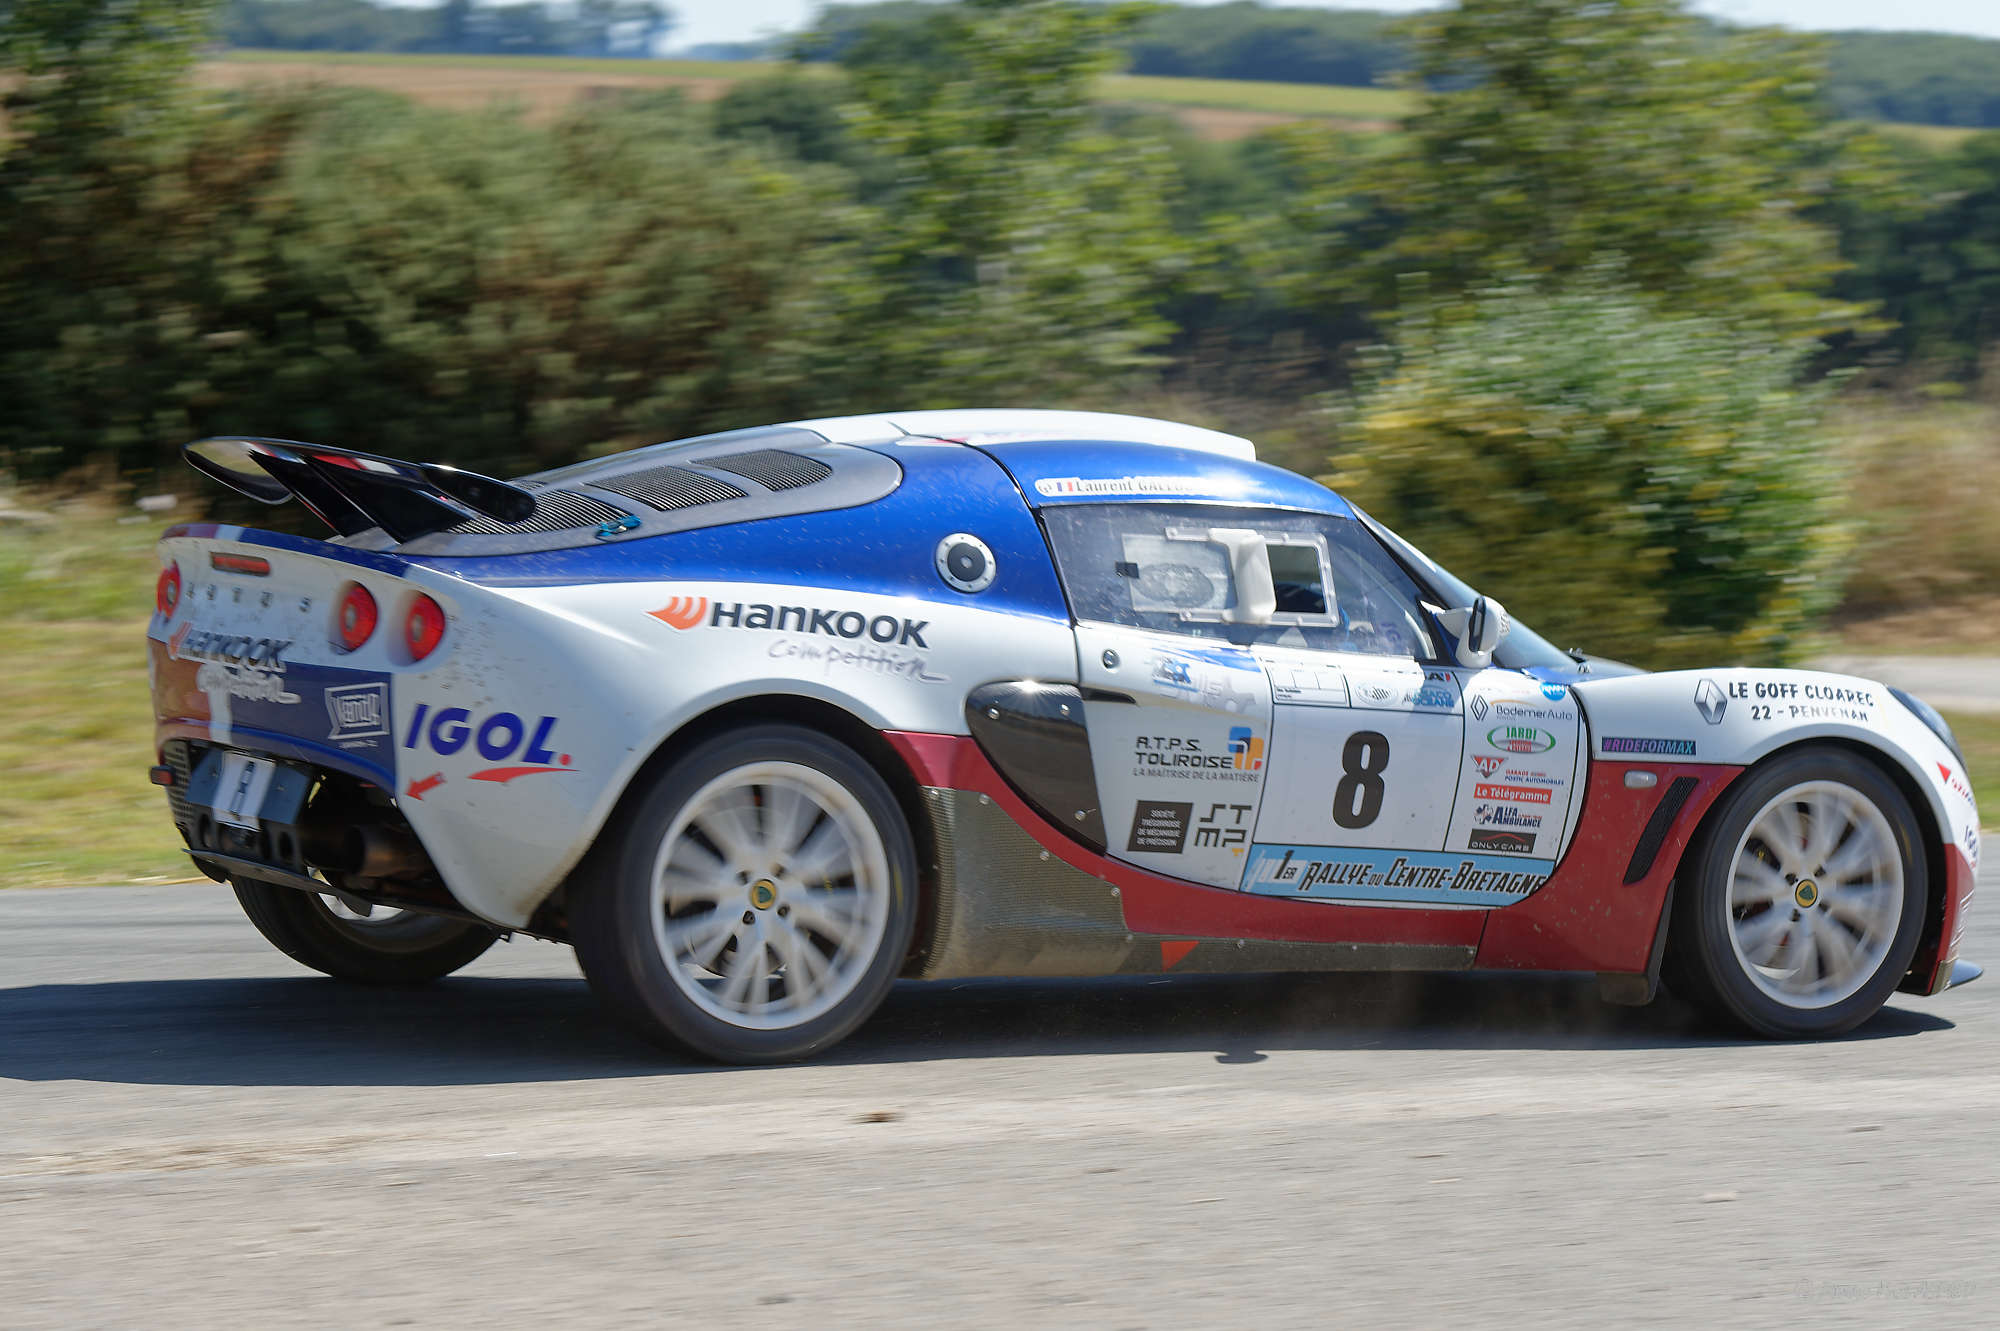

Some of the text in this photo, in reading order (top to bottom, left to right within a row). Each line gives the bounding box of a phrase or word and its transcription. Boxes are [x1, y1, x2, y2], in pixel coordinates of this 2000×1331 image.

[1728, 682, 1873, 707] LE GOFF CLOAREC
[1751, 705, 1772, 721] 22
[1506, 726, 1537, 740] JARDI
[1603, 738, 1694, 754] #RIDEFORMAX
[1133, 767, 1145, 777] LA
[1479, 758, 1500, 772] AD
[1332, 730, 1390, 829] 8
[1477, 786, 1549, 802] Le Télégramme
[1471, 841, 1498, 849] ONLY
[1298, 862, 1373, 891] RALLYE
[1384, 857, 1547, 896] CENTRE-BRETAGNE
